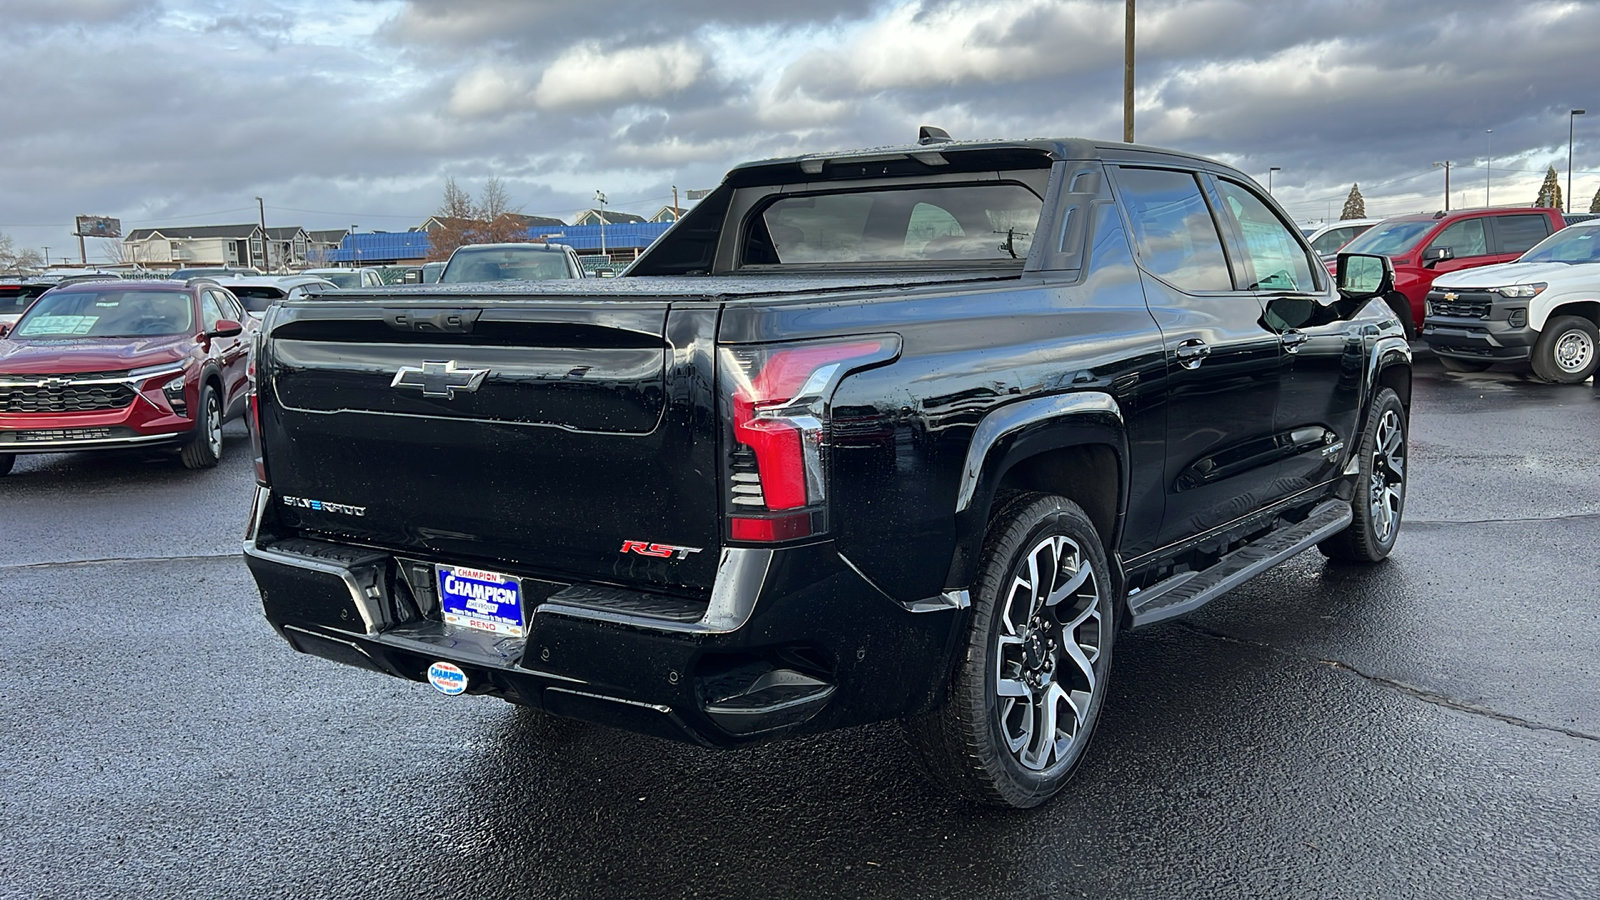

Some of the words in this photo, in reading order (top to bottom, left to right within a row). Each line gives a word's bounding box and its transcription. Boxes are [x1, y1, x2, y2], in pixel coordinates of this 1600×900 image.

[283, 495, 366, 516] SILVERADO
[620, 540, 703, 560] RST
[458, 568, 497, 582] CHAMPION
[444, 575, 517, 605] CHAMPION
[469, 619, 496, 631] RENO
[430, 666, 463, 682] CHAMPION
